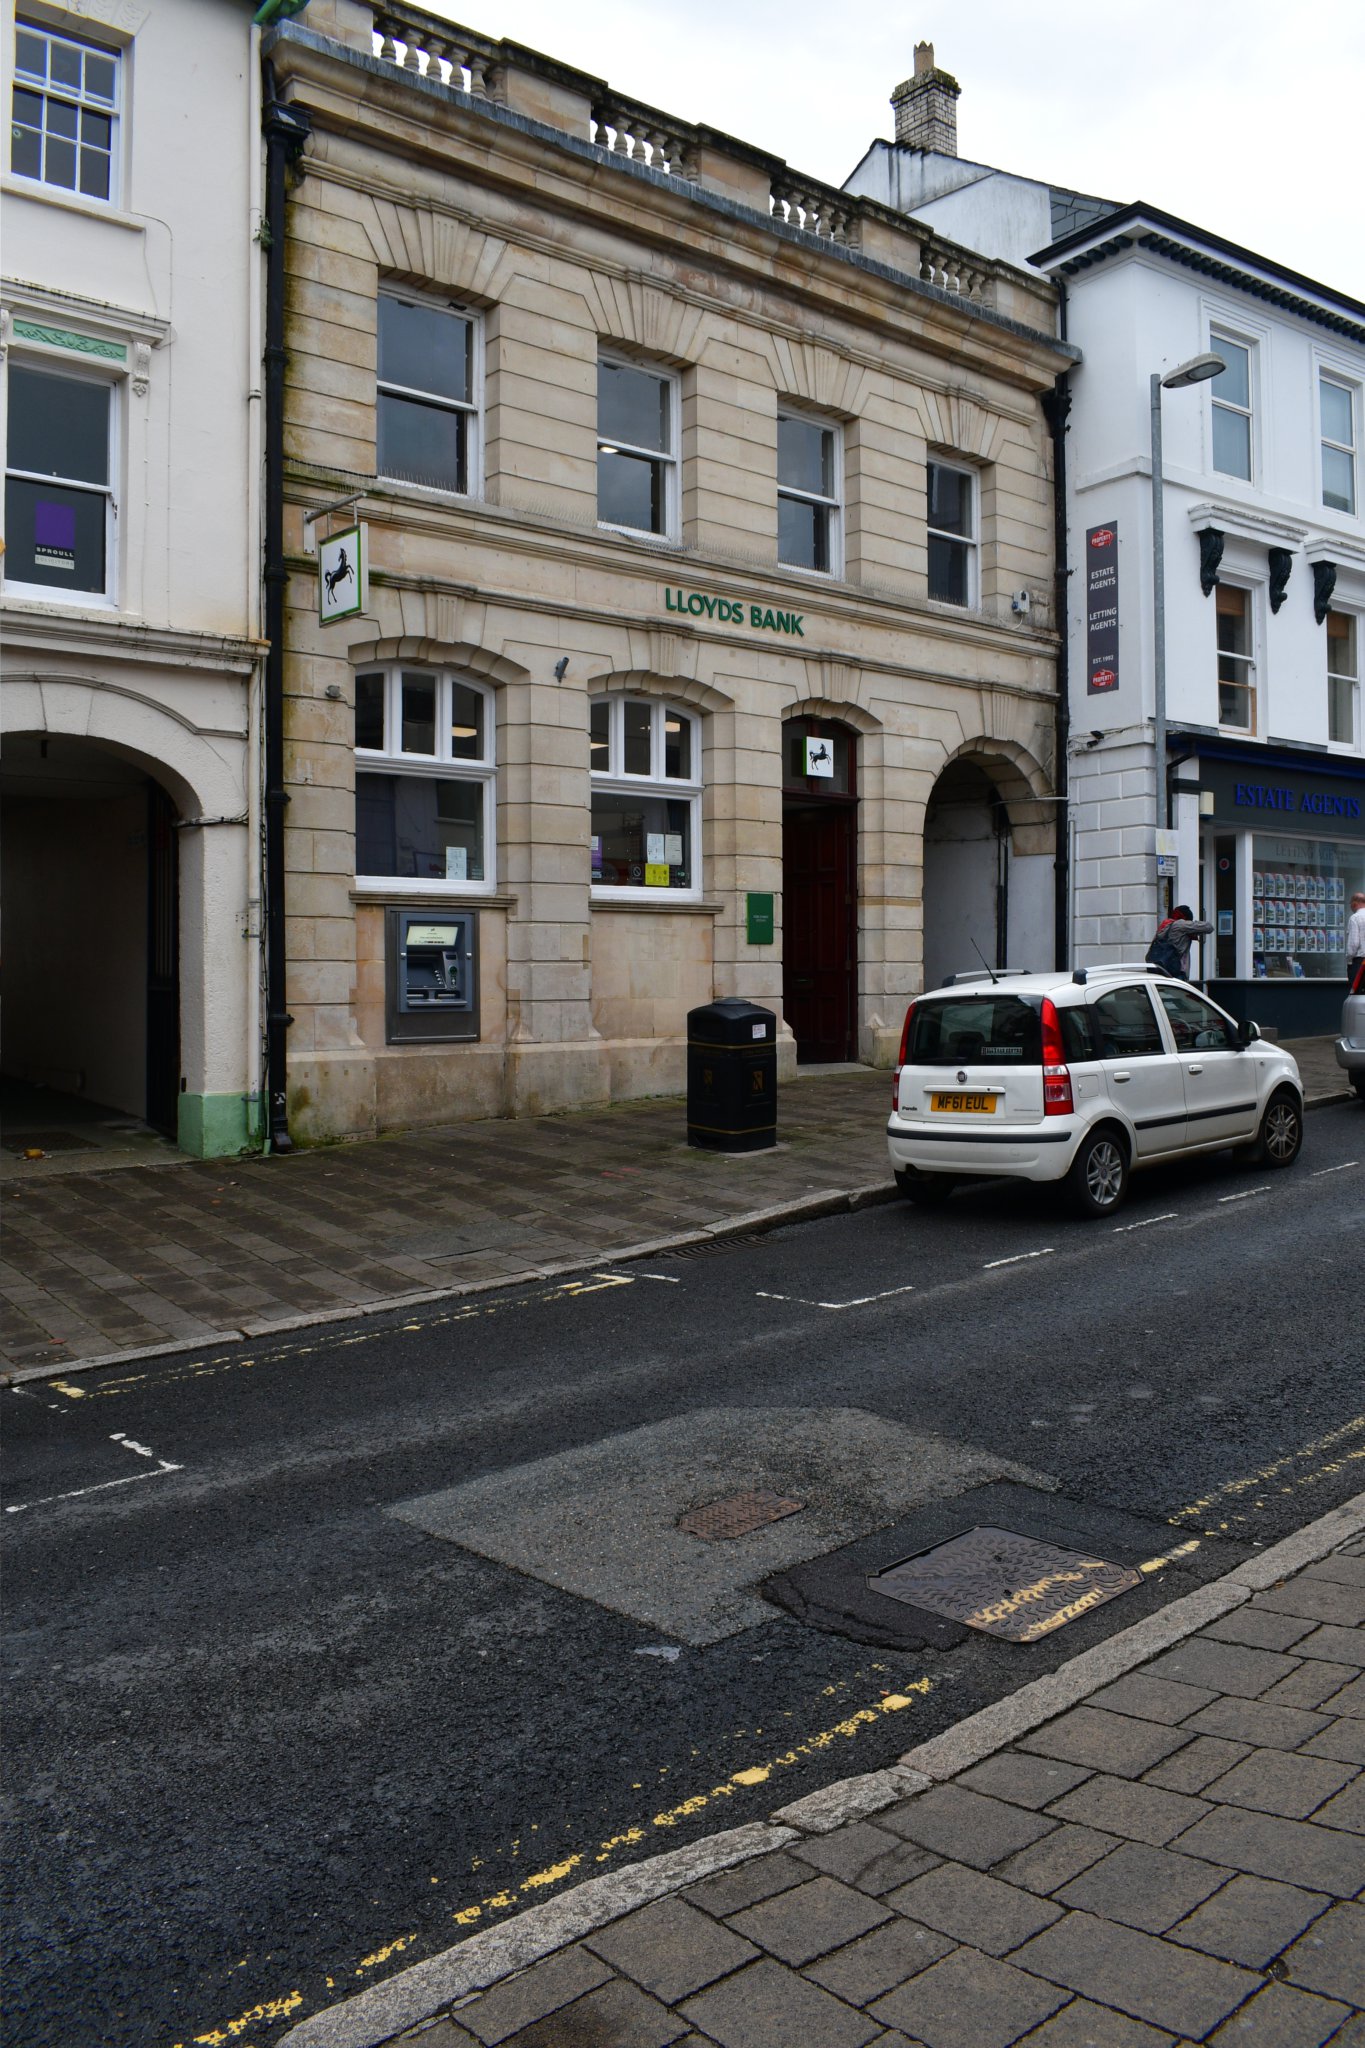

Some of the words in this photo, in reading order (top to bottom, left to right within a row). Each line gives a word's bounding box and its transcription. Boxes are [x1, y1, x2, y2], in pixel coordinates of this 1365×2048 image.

[36, 547, 74, 557] SPROULL
[1091, 567, 1114, 580] ESTATE
[1090, 577, 1116, 591] AGENTS
[665, 587, 745, 624] LLOYDS
[750, 605, 805, 637] BANK
[1089, 608, 1117, 621] LETTING
[1090, 619, 1117, 632] AGENTS
[1235, 783, 1296, 812] ESTATE
[1299, 792, 1361, 818] AGENTS
[937, 1095, 963, 1110] MF61
[965, 1096, 989, 1111] EUL
